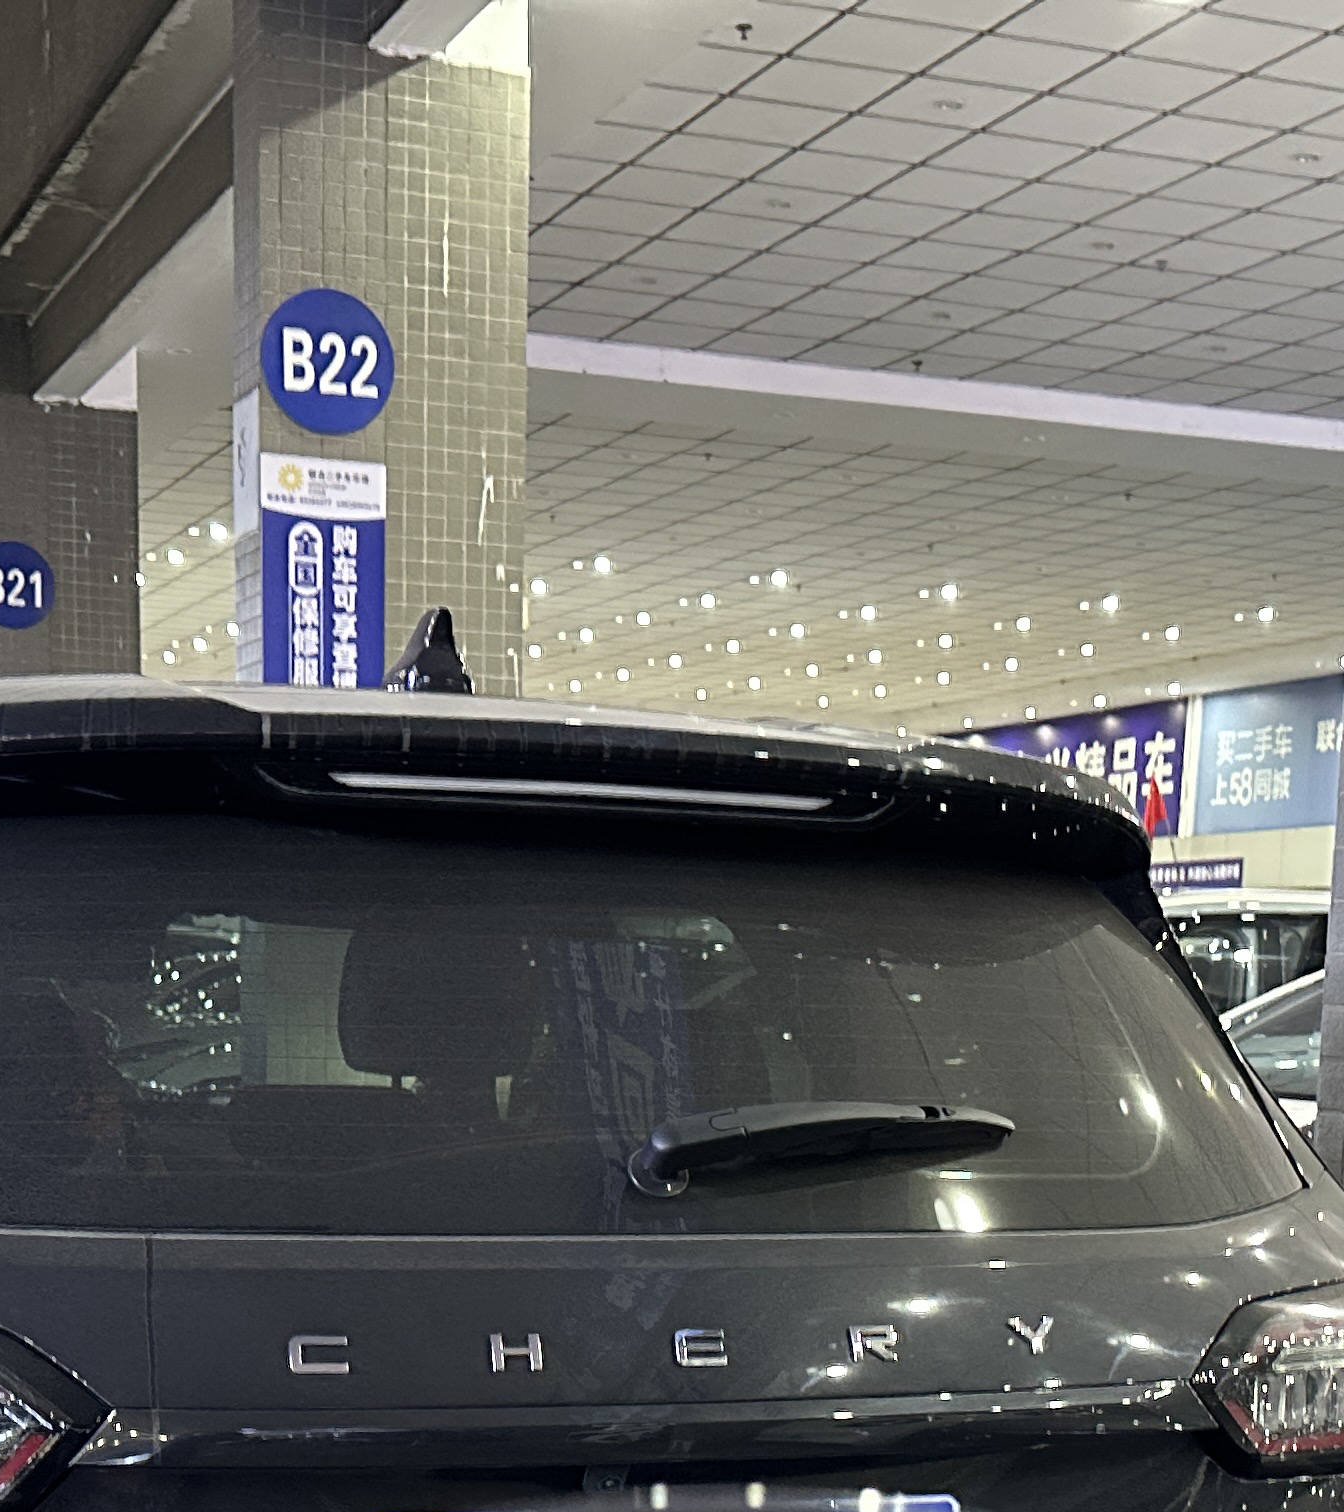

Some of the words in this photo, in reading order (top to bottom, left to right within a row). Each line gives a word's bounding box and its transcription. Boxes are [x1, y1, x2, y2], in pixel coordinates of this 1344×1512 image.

[282, 326, 379, 400] B22
[1216, 723, 1293, 767] 买二手车
[288, 1313, 1055, 1377] CHERY
